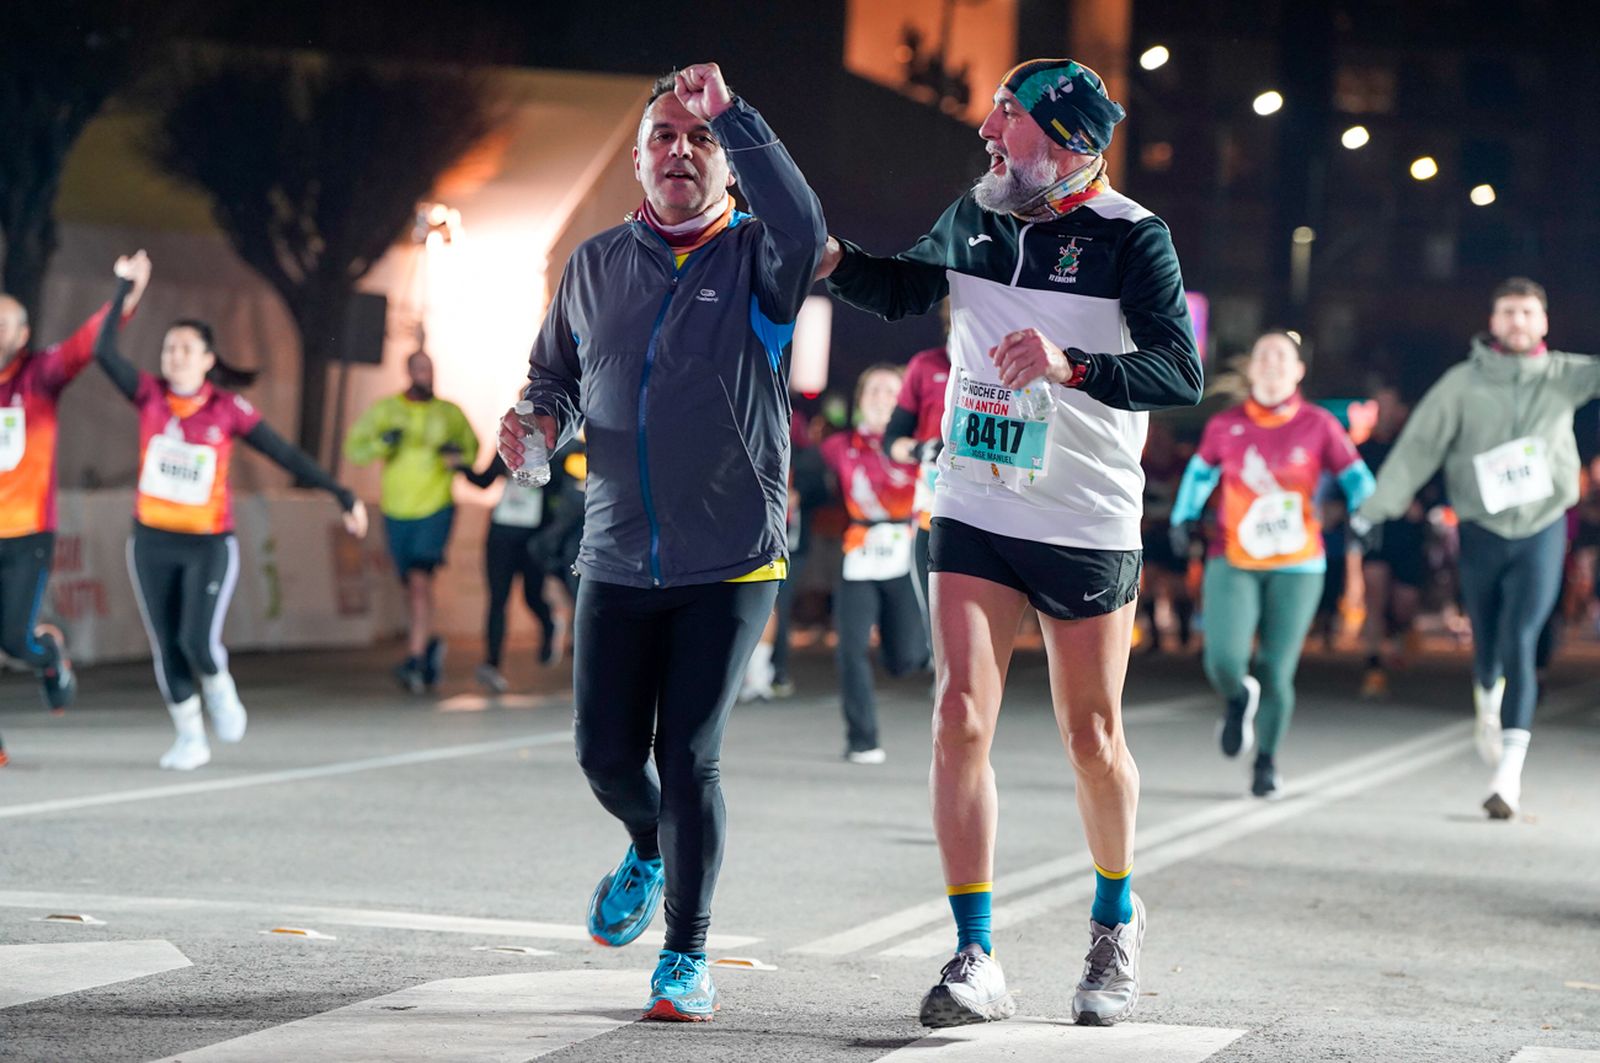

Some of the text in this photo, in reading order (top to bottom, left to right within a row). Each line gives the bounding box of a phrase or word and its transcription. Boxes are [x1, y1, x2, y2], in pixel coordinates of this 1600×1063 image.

[968, 384, 1012, 401] NOCHE DE
[975, 400, 1009, 416] ANTÓN
[966, 413, 1026, 454] 8417
[987, 452, 1013, 464] MANUEL
